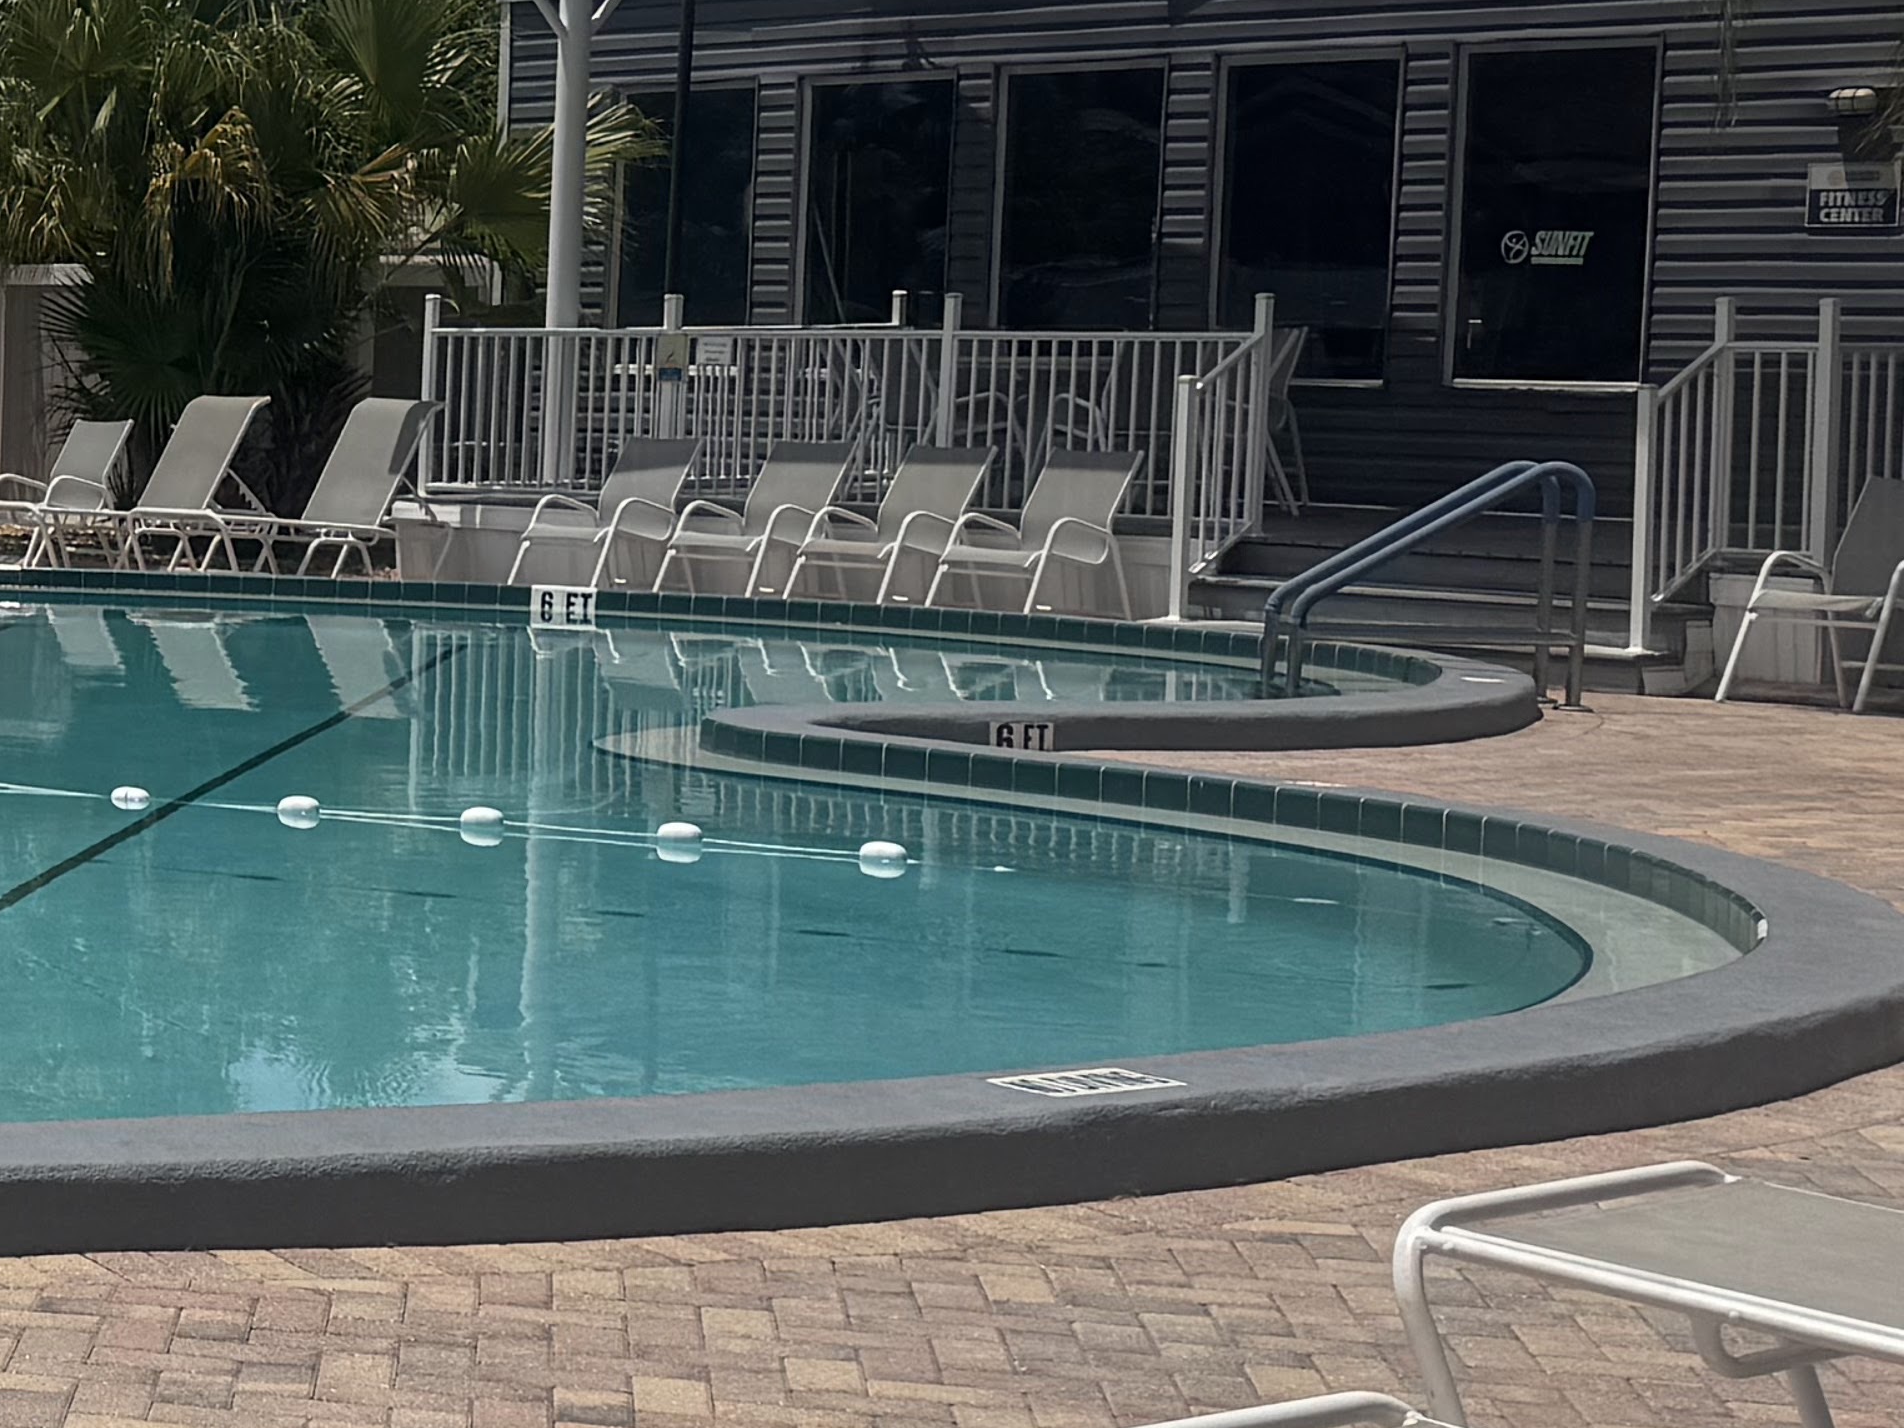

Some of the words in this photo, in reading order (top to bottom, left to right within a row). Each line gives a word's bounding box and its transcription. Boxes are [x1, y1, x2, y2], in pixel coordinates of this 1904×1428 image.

[1819, 191, 1889, 207] FITNESS
[1819, 207, 1884, 223] CENTER
[1530, 230, 1594, 256] SUNFIT
[541, 591, 554, 612] 6
[566, 592, 593, 612] FT
[996, 723, 1014, 749] 6
[1024, 724, 1049, 752] FT
